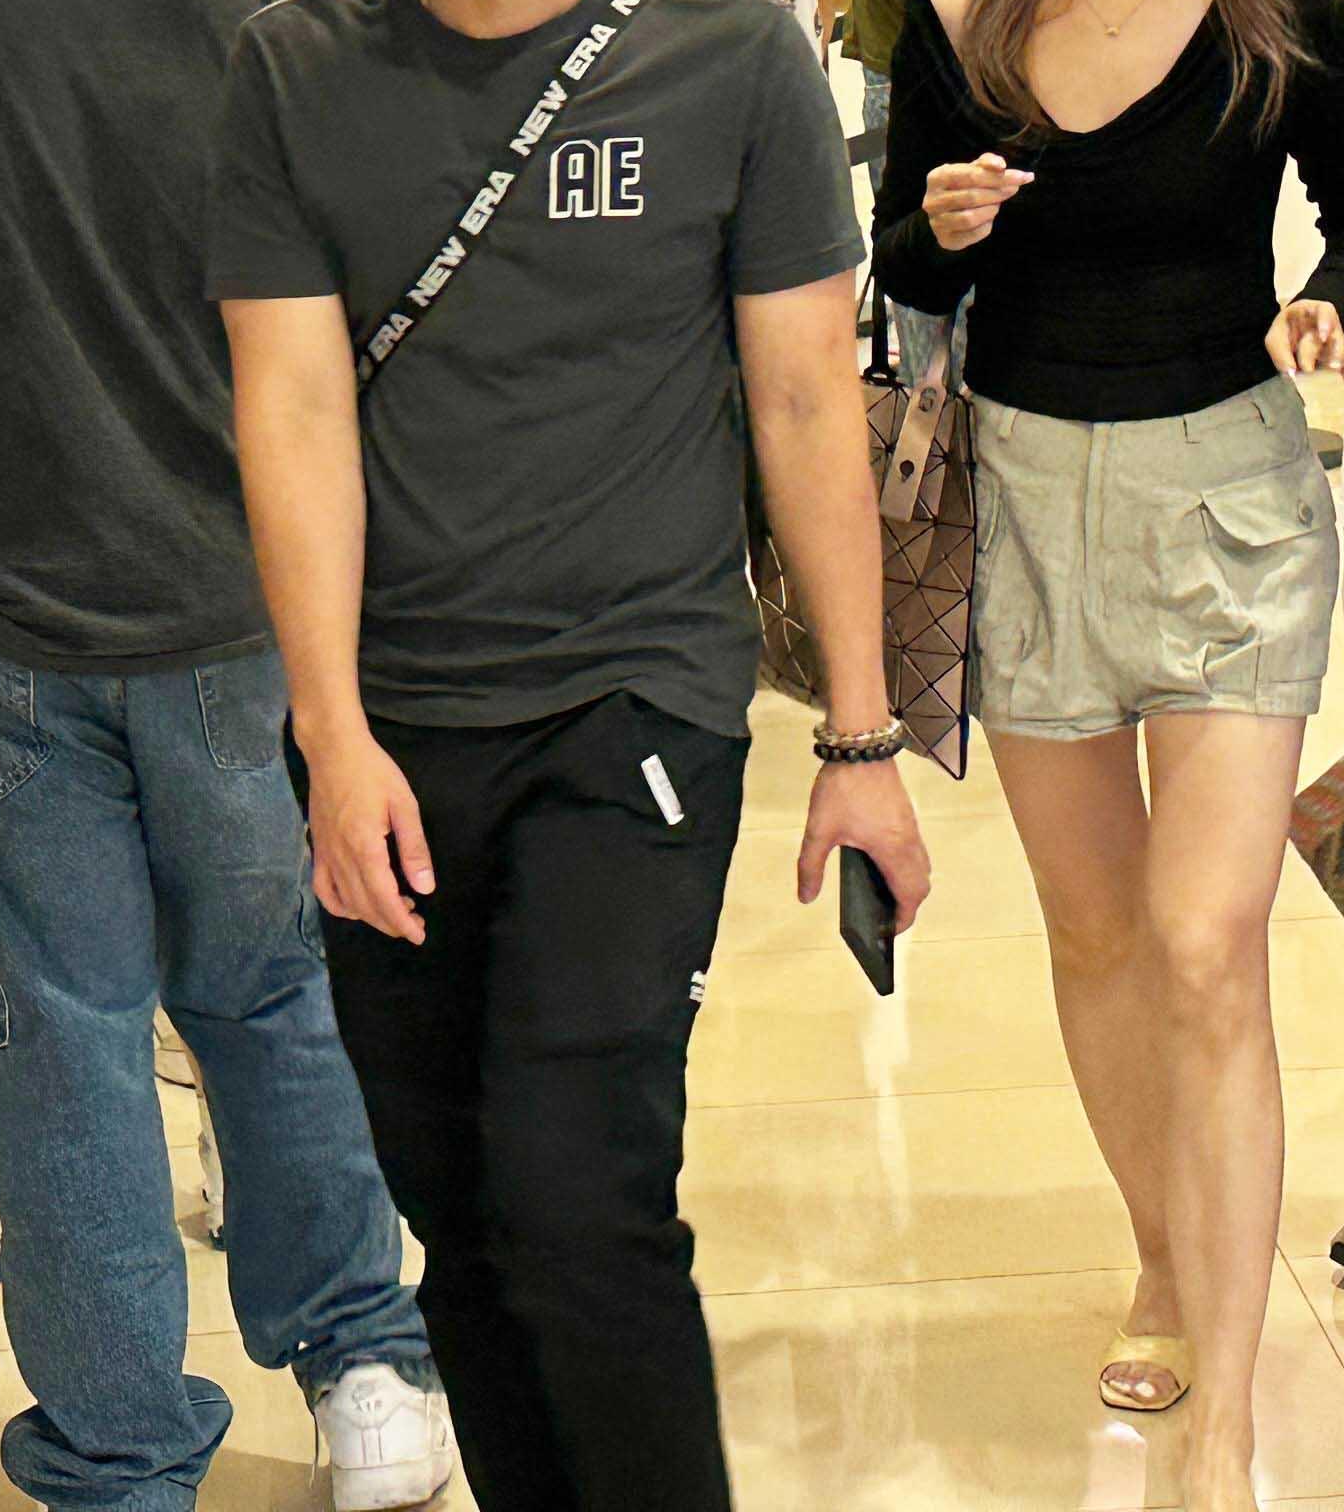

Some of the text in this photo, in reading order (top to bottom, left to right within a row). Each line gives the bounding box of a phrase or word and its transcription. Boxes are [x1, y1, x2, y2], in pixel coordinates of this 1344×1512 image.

[367, 312, 414, 362] ERA
[406, 235, 467, 307] NEW
[459, 170, 516, 236] ERA
[509, 79, 568, 157] NEW
[561, 23, 617, 80] ERA
[549, 137, 644, 219] AE
